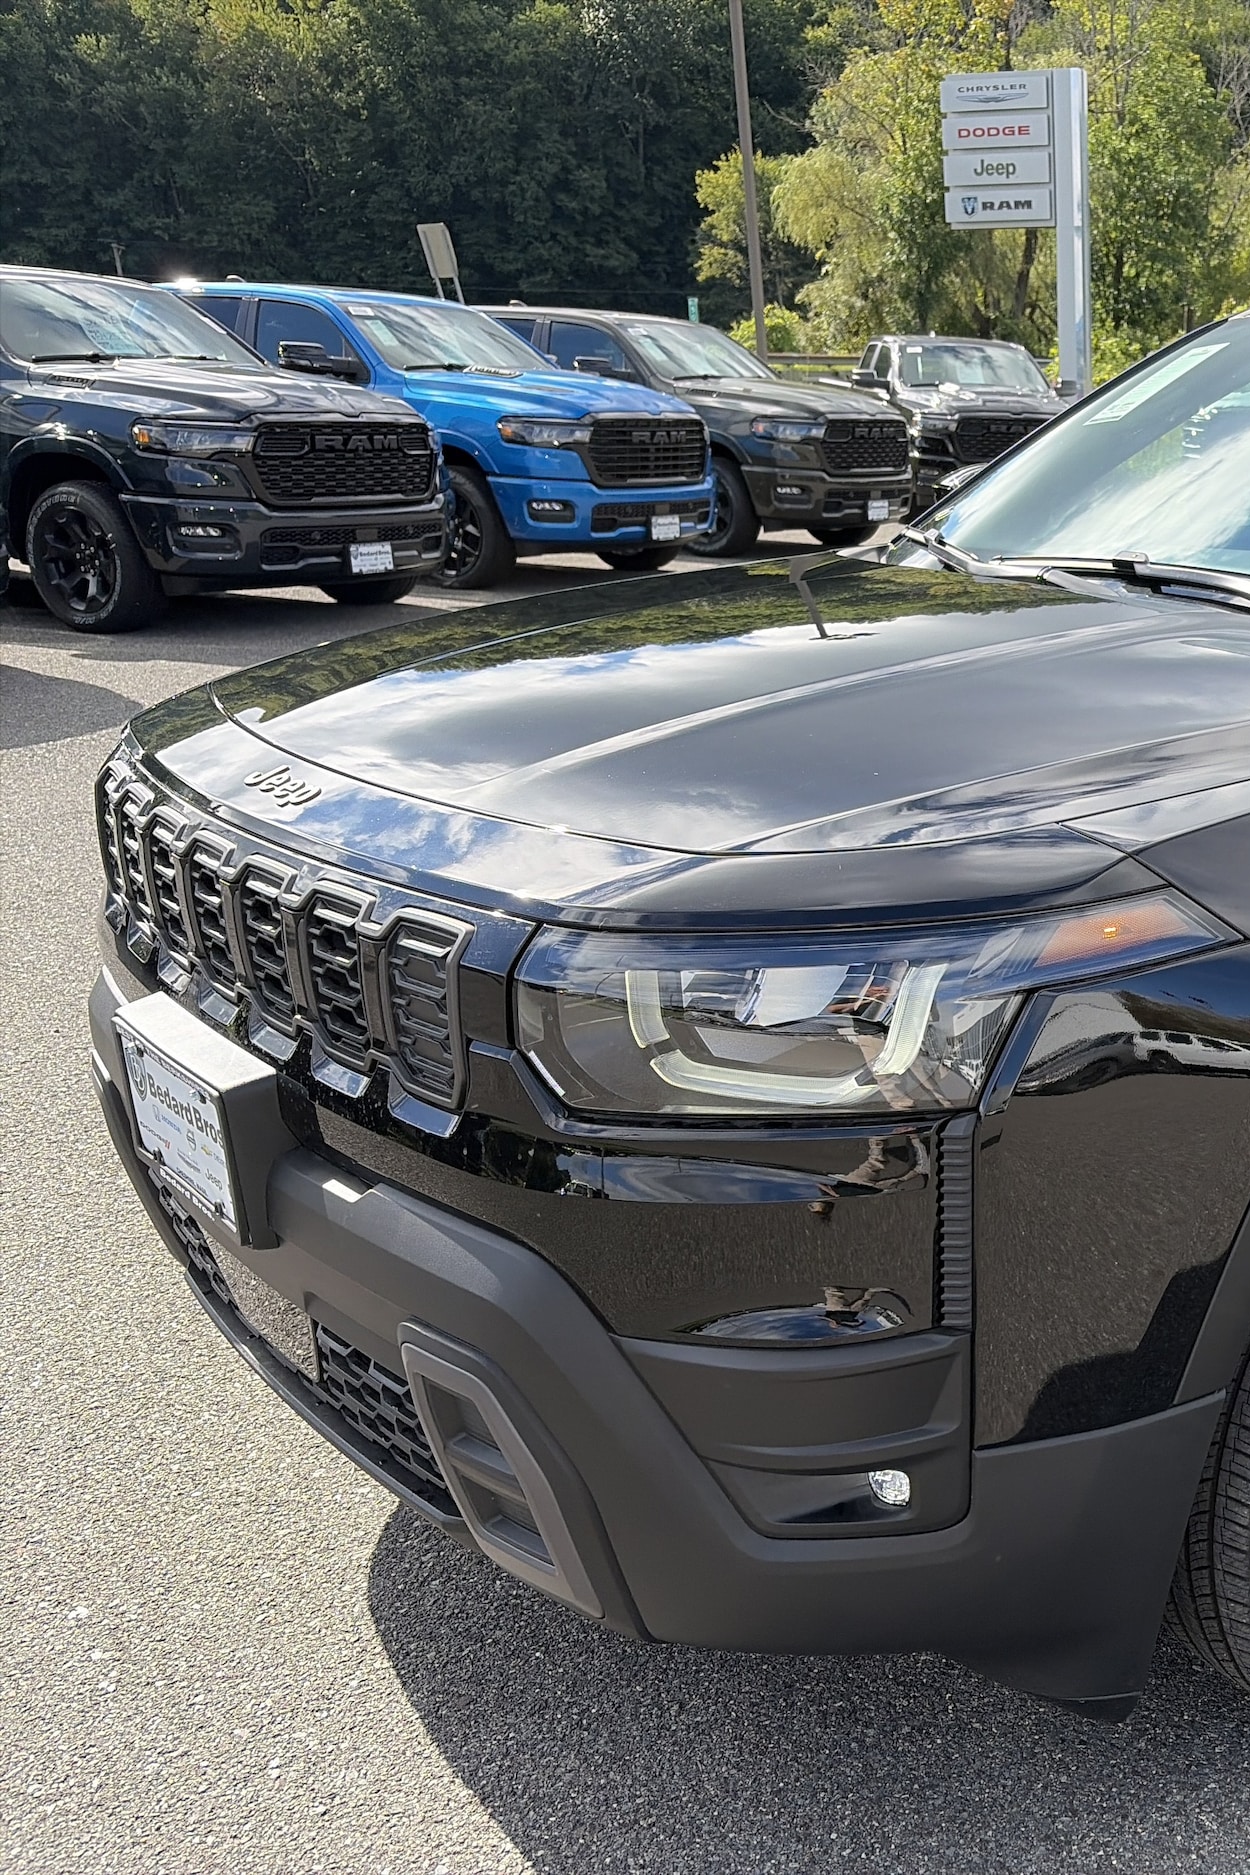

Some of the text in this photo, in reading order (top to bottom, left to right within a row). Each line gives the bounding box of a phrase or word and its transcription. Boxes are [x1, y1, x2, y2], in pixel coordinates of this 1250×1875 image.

[957, 83, 1027, 93] CHRYSLER
[957, 125, 1031, 139] DODGE
[973, 159, 1016, 179] Jeep
[981, 200, 1033, 211] RAM
[314, 434, 398, 451] RAM
[631, 431, 686, 444] RAM
[243, 764, 322, 808] Jeep
[204, 1168, 223, 1191] Jeep
[160, 1167, 191, 1200] Bedard
[192, 1196, 215, 1222] Bros.
